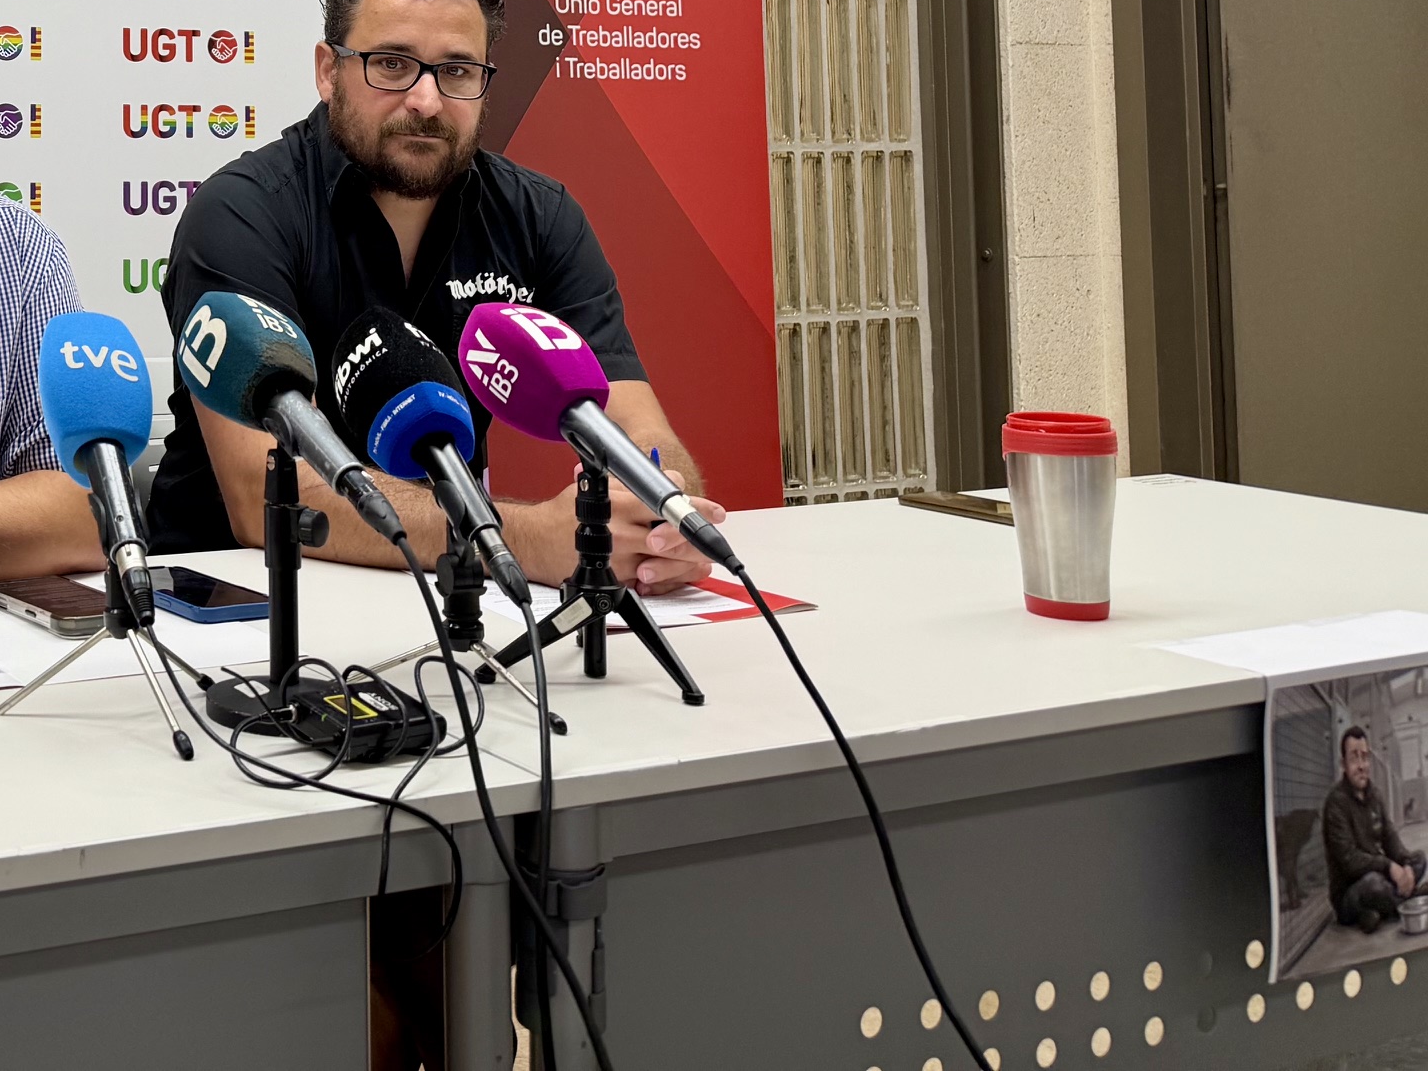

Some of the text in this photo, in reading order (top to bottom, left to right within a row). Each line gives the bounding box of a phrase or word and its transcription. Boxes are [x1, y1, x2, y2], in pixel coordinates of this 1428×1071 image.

[123, 28, 201, 63] UGT
[538, 24, 701, 50] de Treballadores
[555, 56, 687, 81] i Treballadors
[123, 104, 201, 139] UGT
[123, 258, 170, 294] UG
[60, 341, 139, 382] tve
